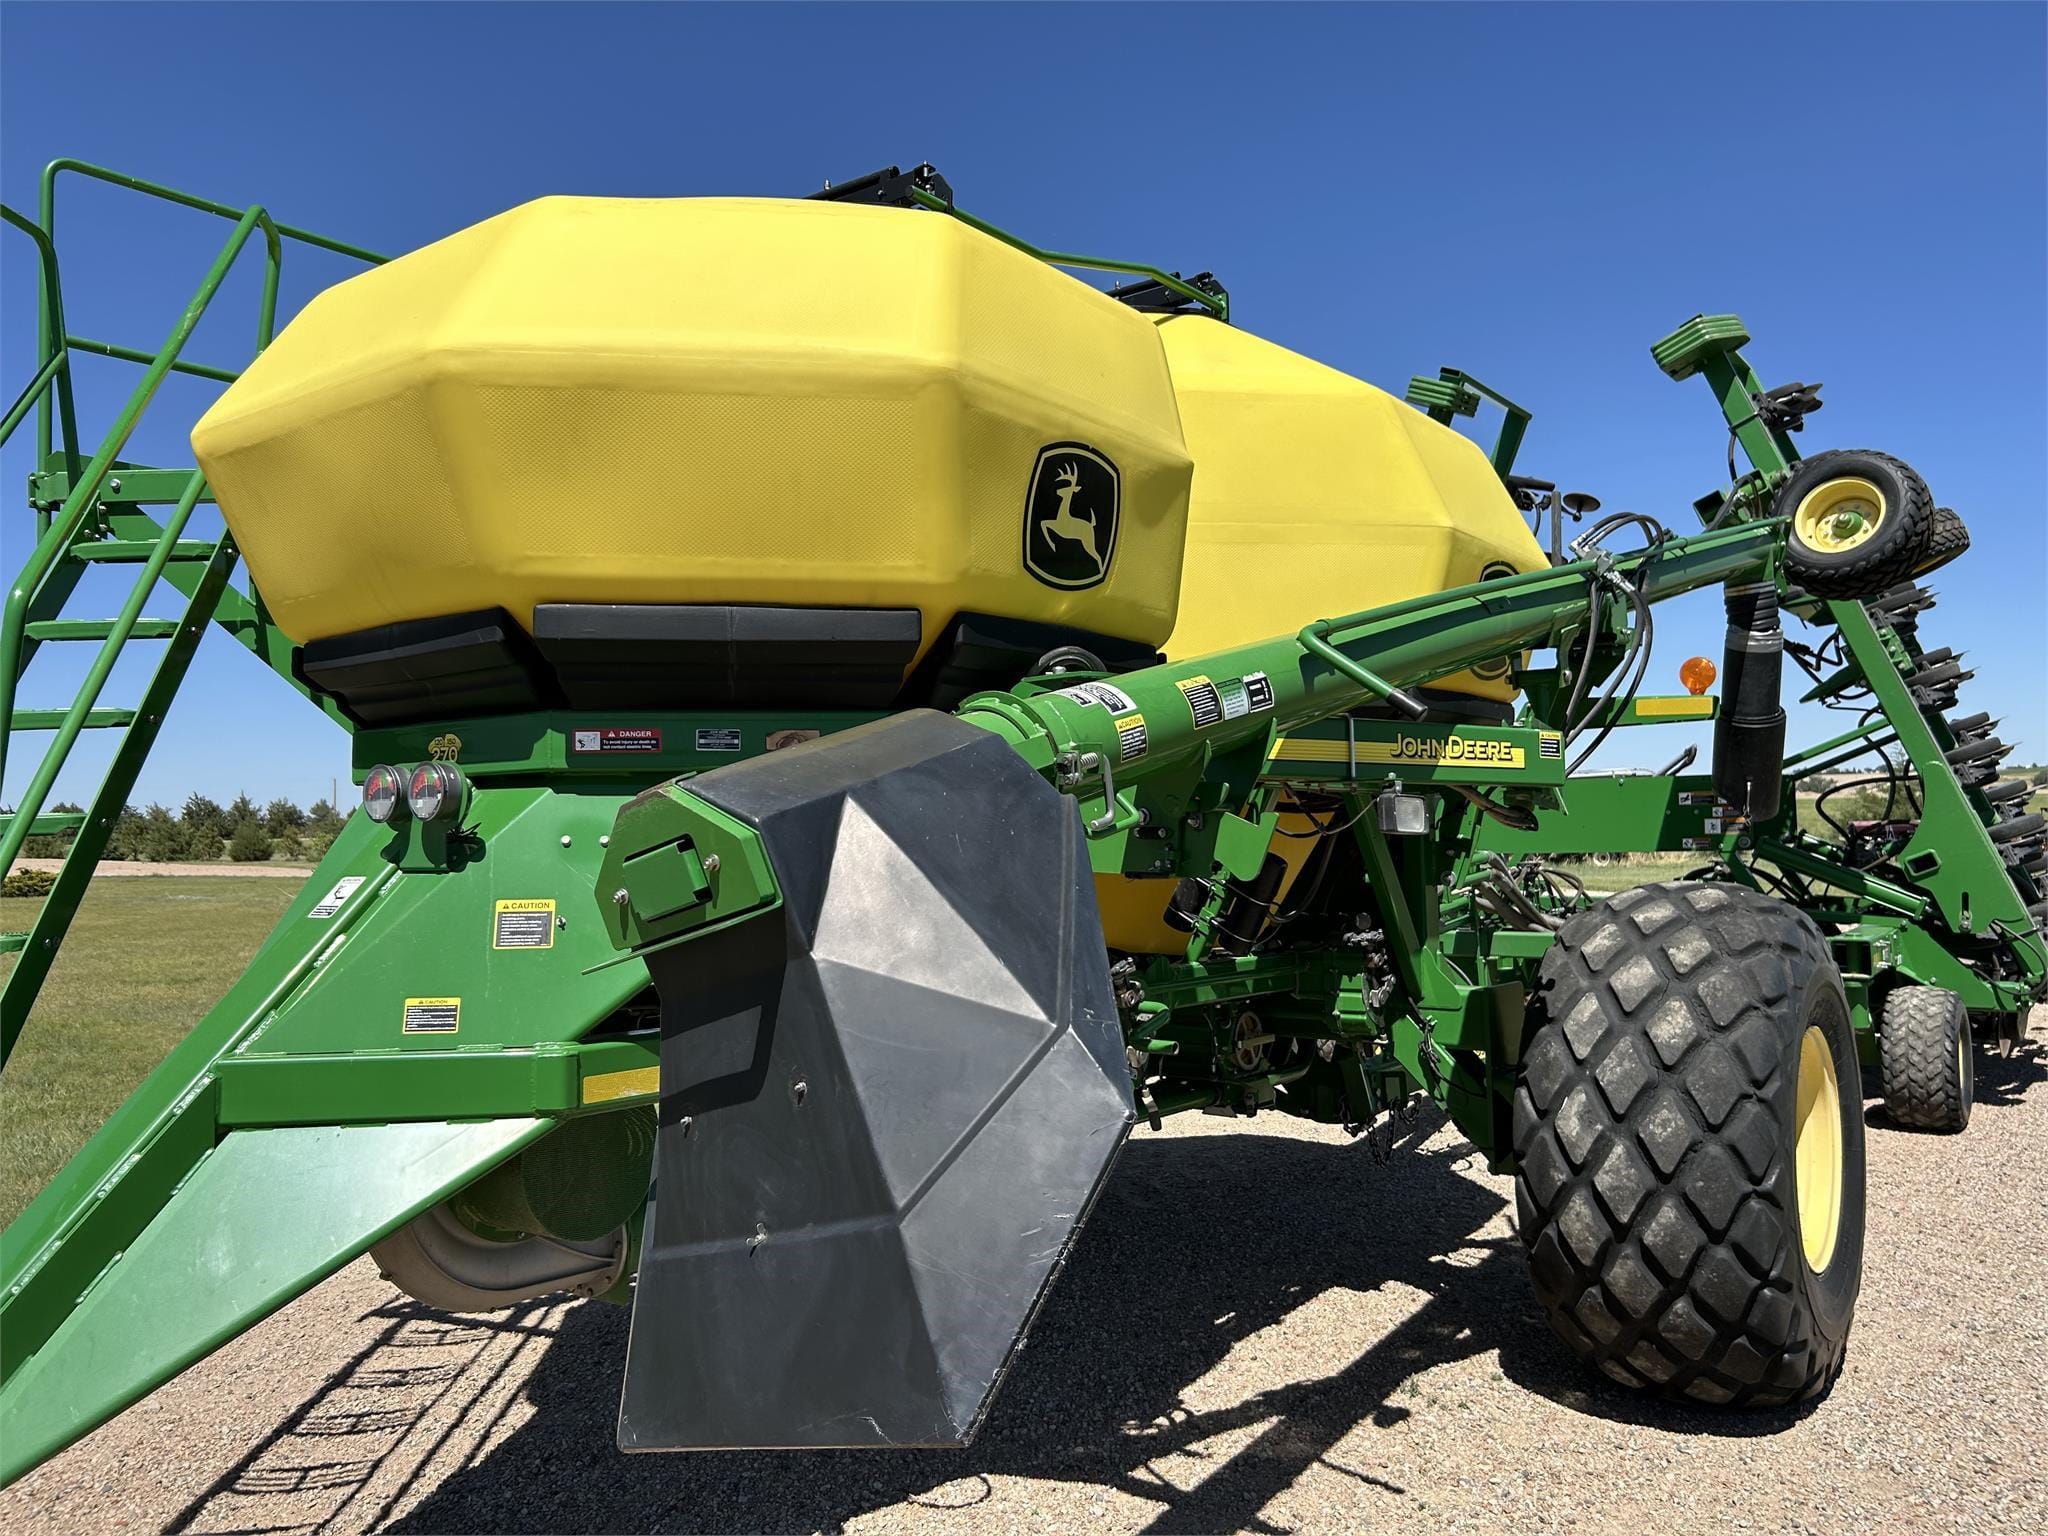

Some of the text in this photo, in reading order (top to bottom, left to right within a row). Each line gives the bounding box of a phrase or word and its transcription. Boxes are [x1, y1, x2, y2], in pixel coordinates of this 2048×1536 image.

[432, 746, 458, 763] 270
[1391, 733, 1446, 758] JOHN
[1448, 735, 1513, 760] DEERE
